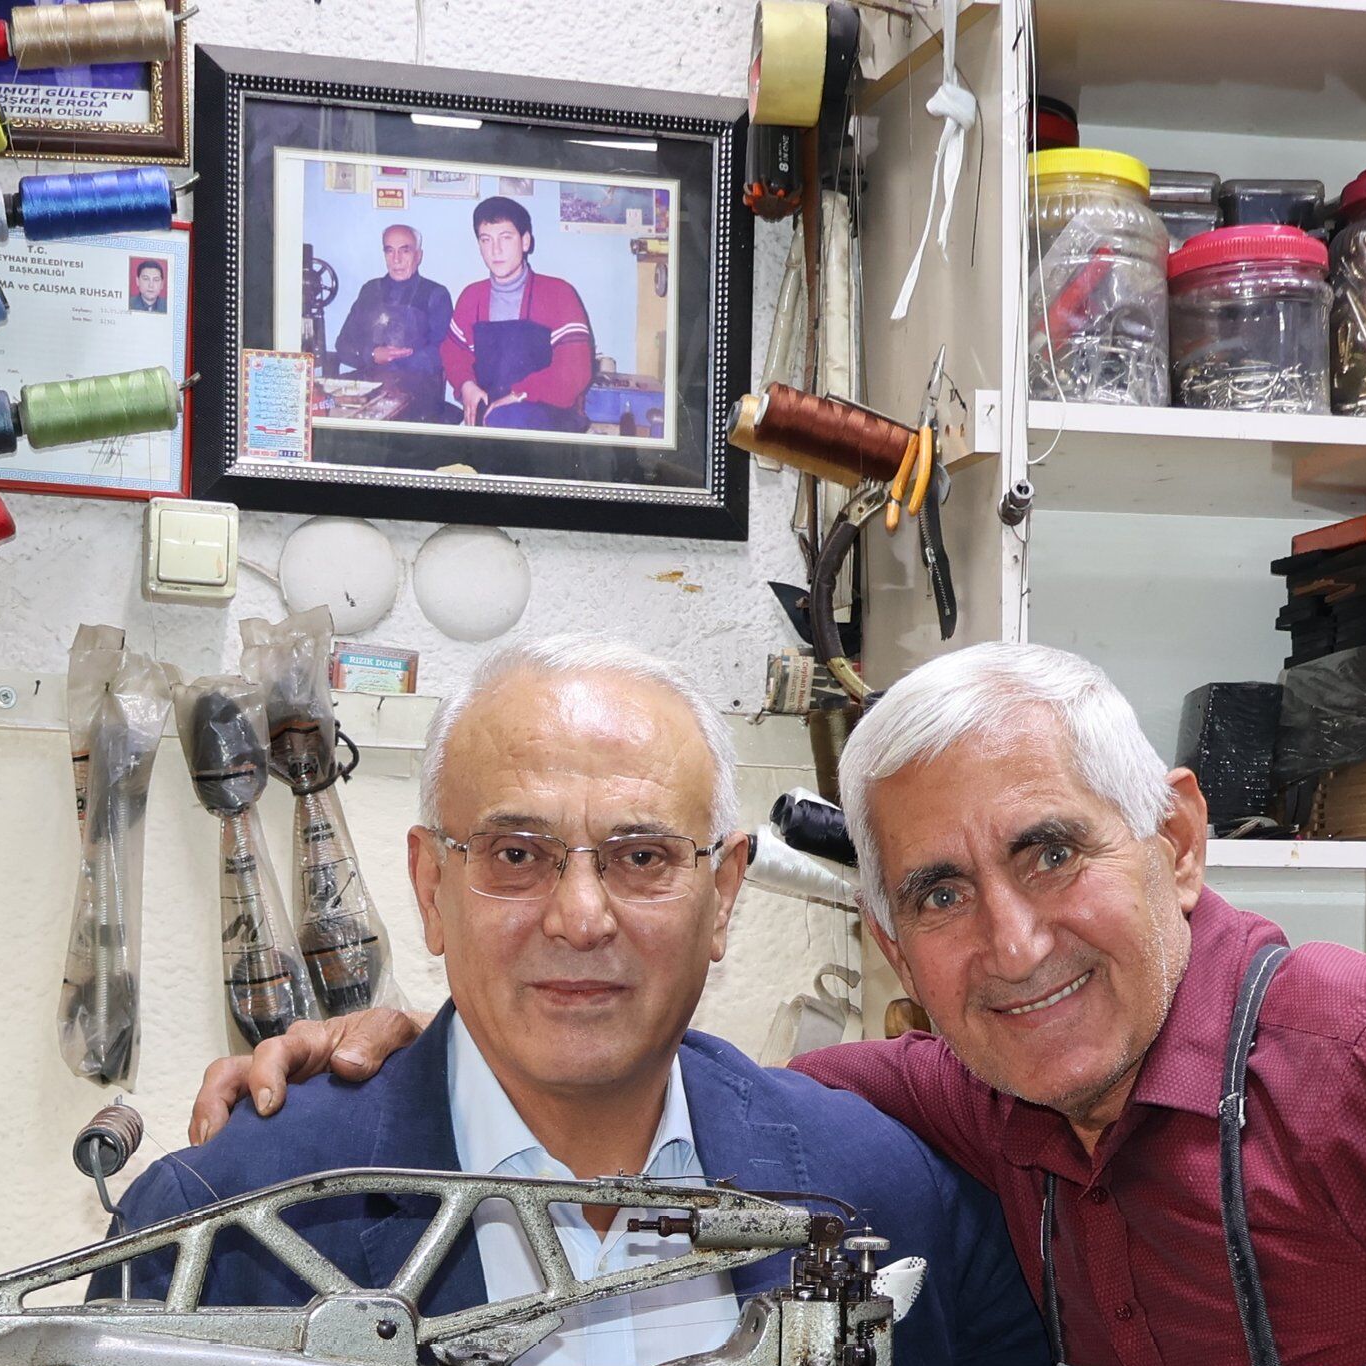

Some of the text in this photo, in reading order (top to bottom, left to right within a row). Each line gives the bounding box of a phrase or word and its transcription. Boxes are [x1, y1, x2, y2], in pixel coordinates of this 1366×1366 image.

[45, 88, 134, 101] GÜLEÇTEN
[53, 99, 108, 109] EROLA
[1, 105, 102, 118] ATIRAM OLSUN
[27, 245, 47, 255] T.C.
[30, 256, 84, 269] BELEDİYESİ
[9, 264, 65, 279] BAŞKANLIĞI
[18, 284, 30, 292] ve
[32, 282, 77, 297] ÇALIŞMA
[79, 287, 123, 300] RUHSATI
